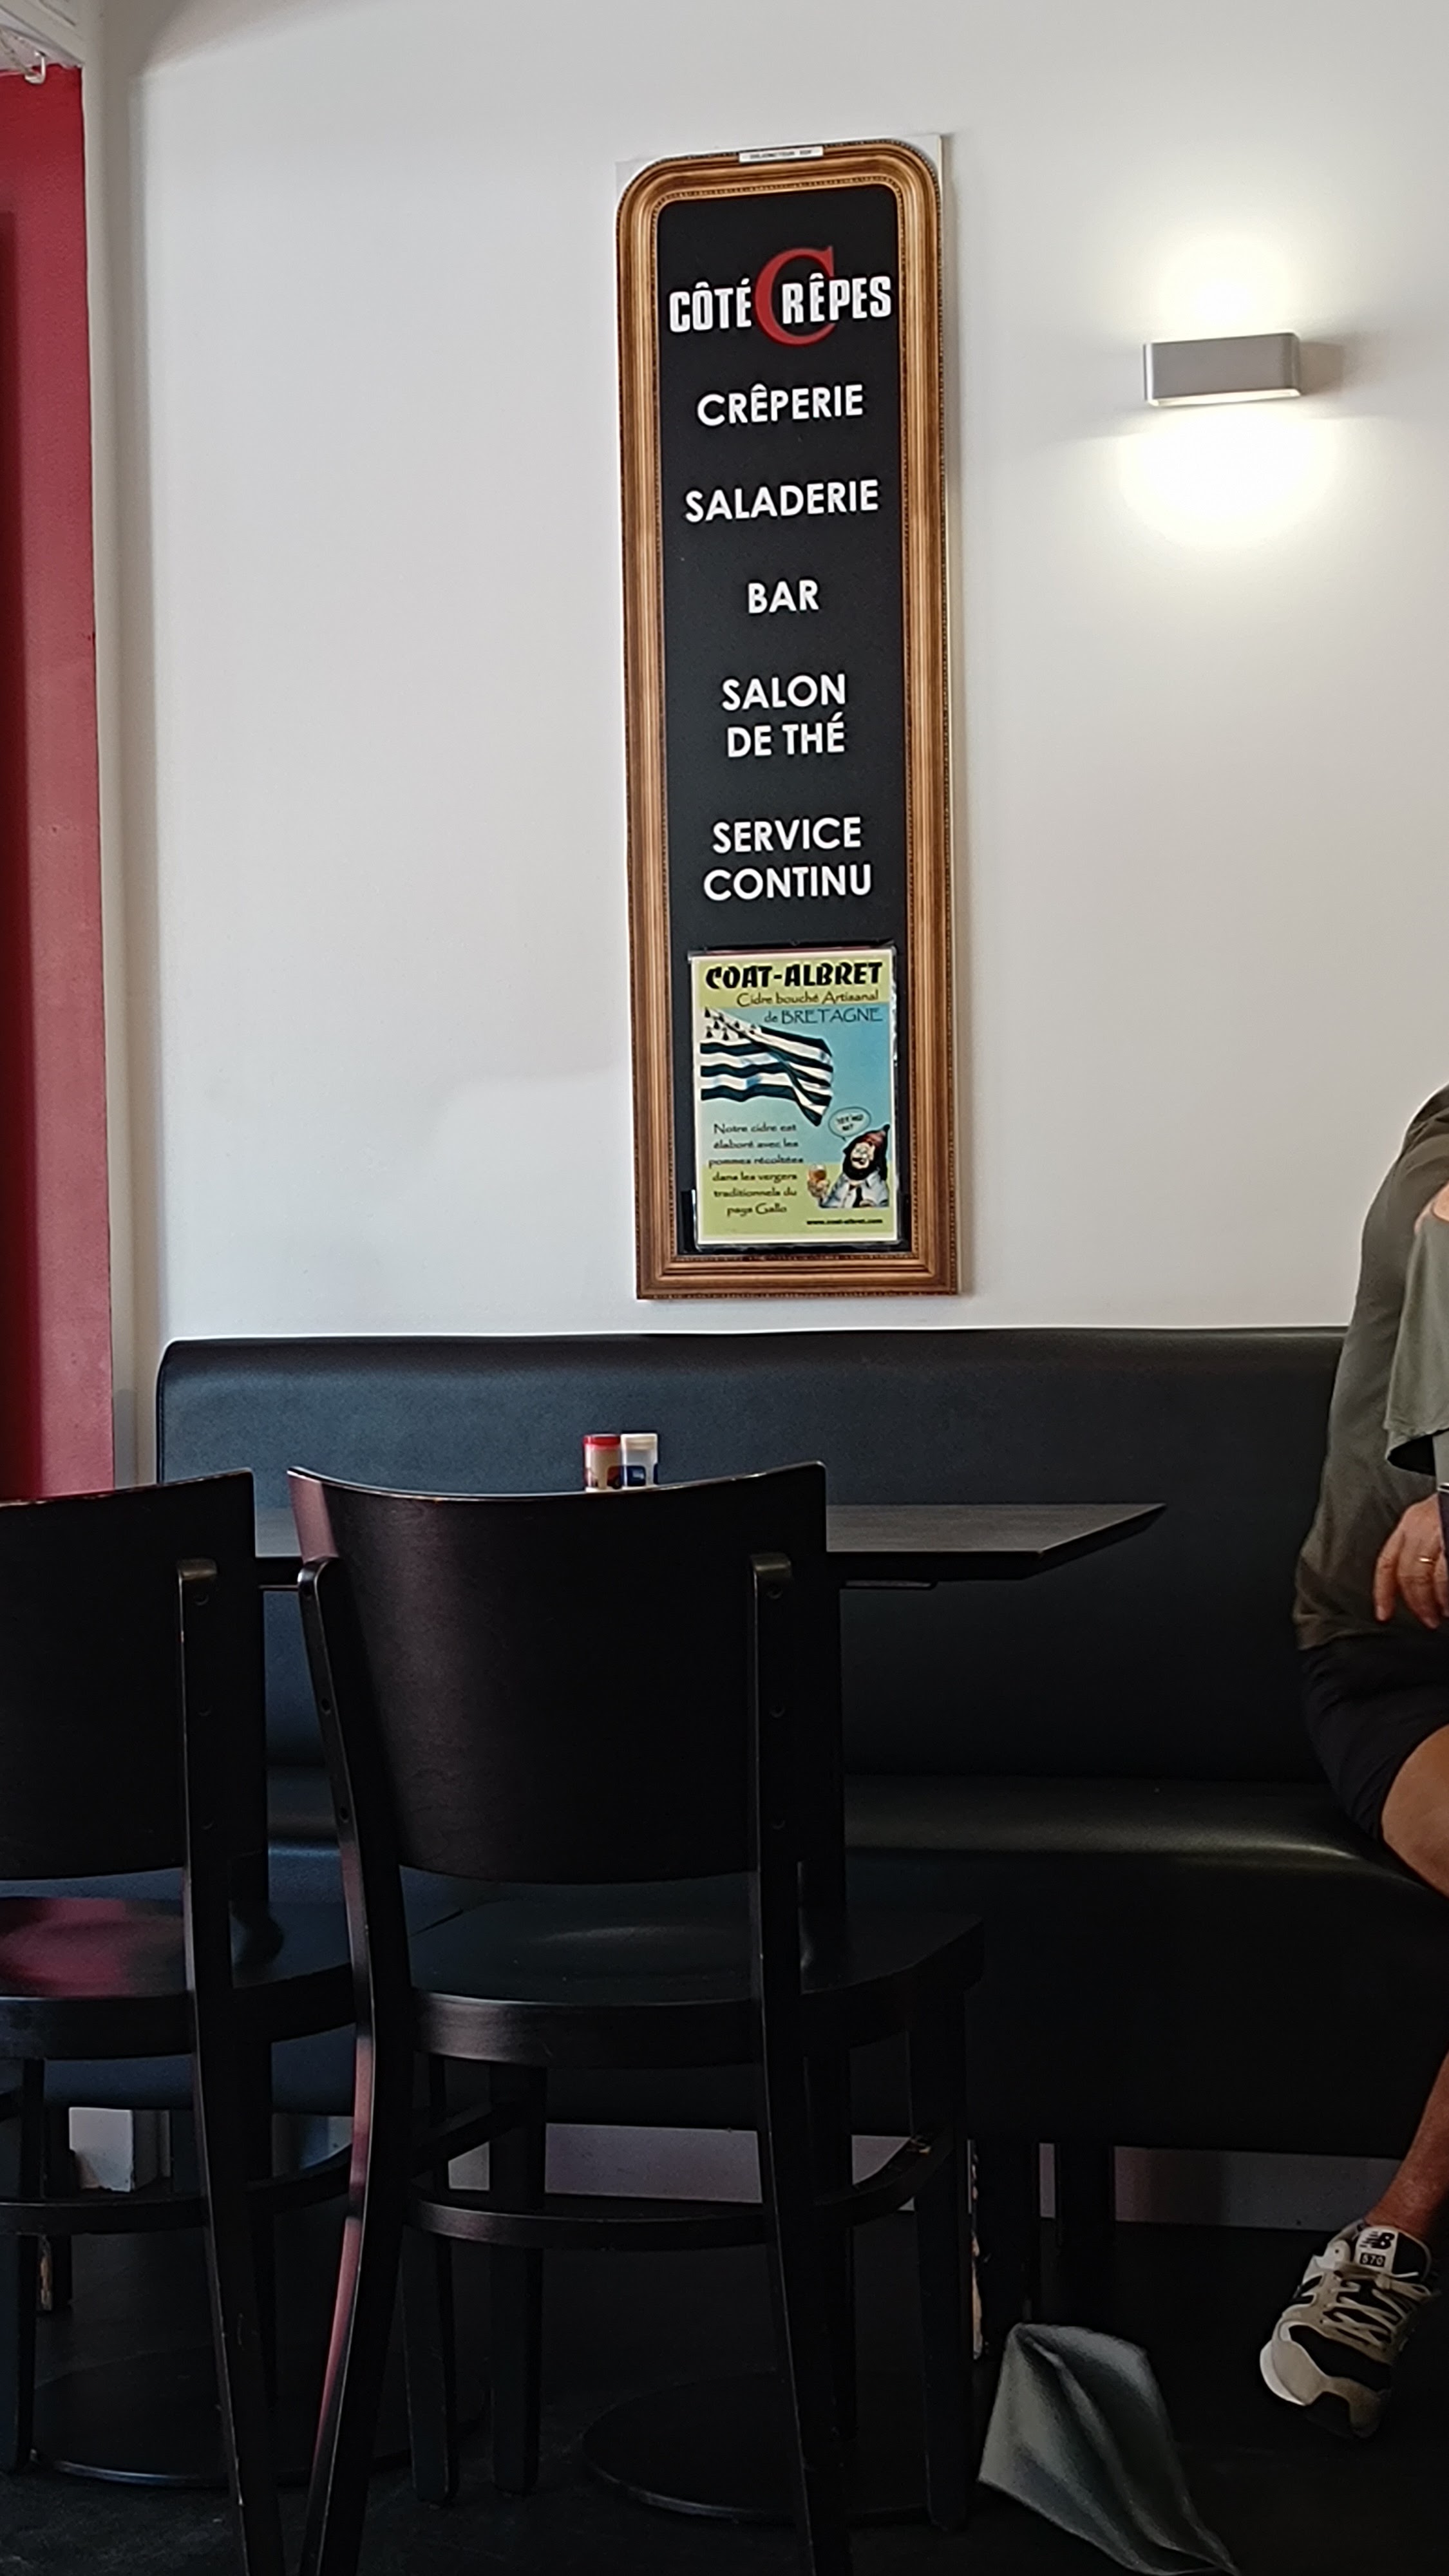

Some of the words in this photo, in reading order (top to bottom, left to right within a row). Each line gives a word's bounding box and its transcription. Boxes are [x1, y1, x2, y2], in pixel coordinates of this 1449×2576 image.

[669, 278, 752, 332] CÔTÉ
[697, 383, 864, 426] CRÊPERIE
[685, 479, 878, 523] SALADERIE
[748, 580, 819, 613] BAR
[722, 674, 846, 710] SALON
[728, 725, 772, 757] DE
[782, 712, 844, 755] THÉ
[713, 817, 861, 853] SERVICE
[704, 864, 870, 900] CONTINU
[706, 962, 882, 989] COAT-ALBRET
[737, 992, 772, 1007] Cidre
[775, 990, 819, 1004] bouché
[821, 989, 879, 1004] Artisanal
[764, 1011, 778, 1023] de
[781, 1007, 884, 1024] BRETAGNE
[714, 1123, 748, 1134] Notre
[751, 1122, 777, 1132] cidre
[714, 1139, 753, 1149] élaboré
[783, 1137, 799, 1147] les
[708, 1159, 752, 1169] pommes
[754, 1154, 804, 1164] récoltées
[712, 1171, 738, 1181] dans
[741, 1171, 755, 1180] les
[758, 1174, 797, 1184] vergers
[714, 1188, 781, 1197] traditionnels
[783, 1187, 797, 1196] du
[727, 1208, 753, 1217] pays
[755, 1202, 787, 1215] Gallo
